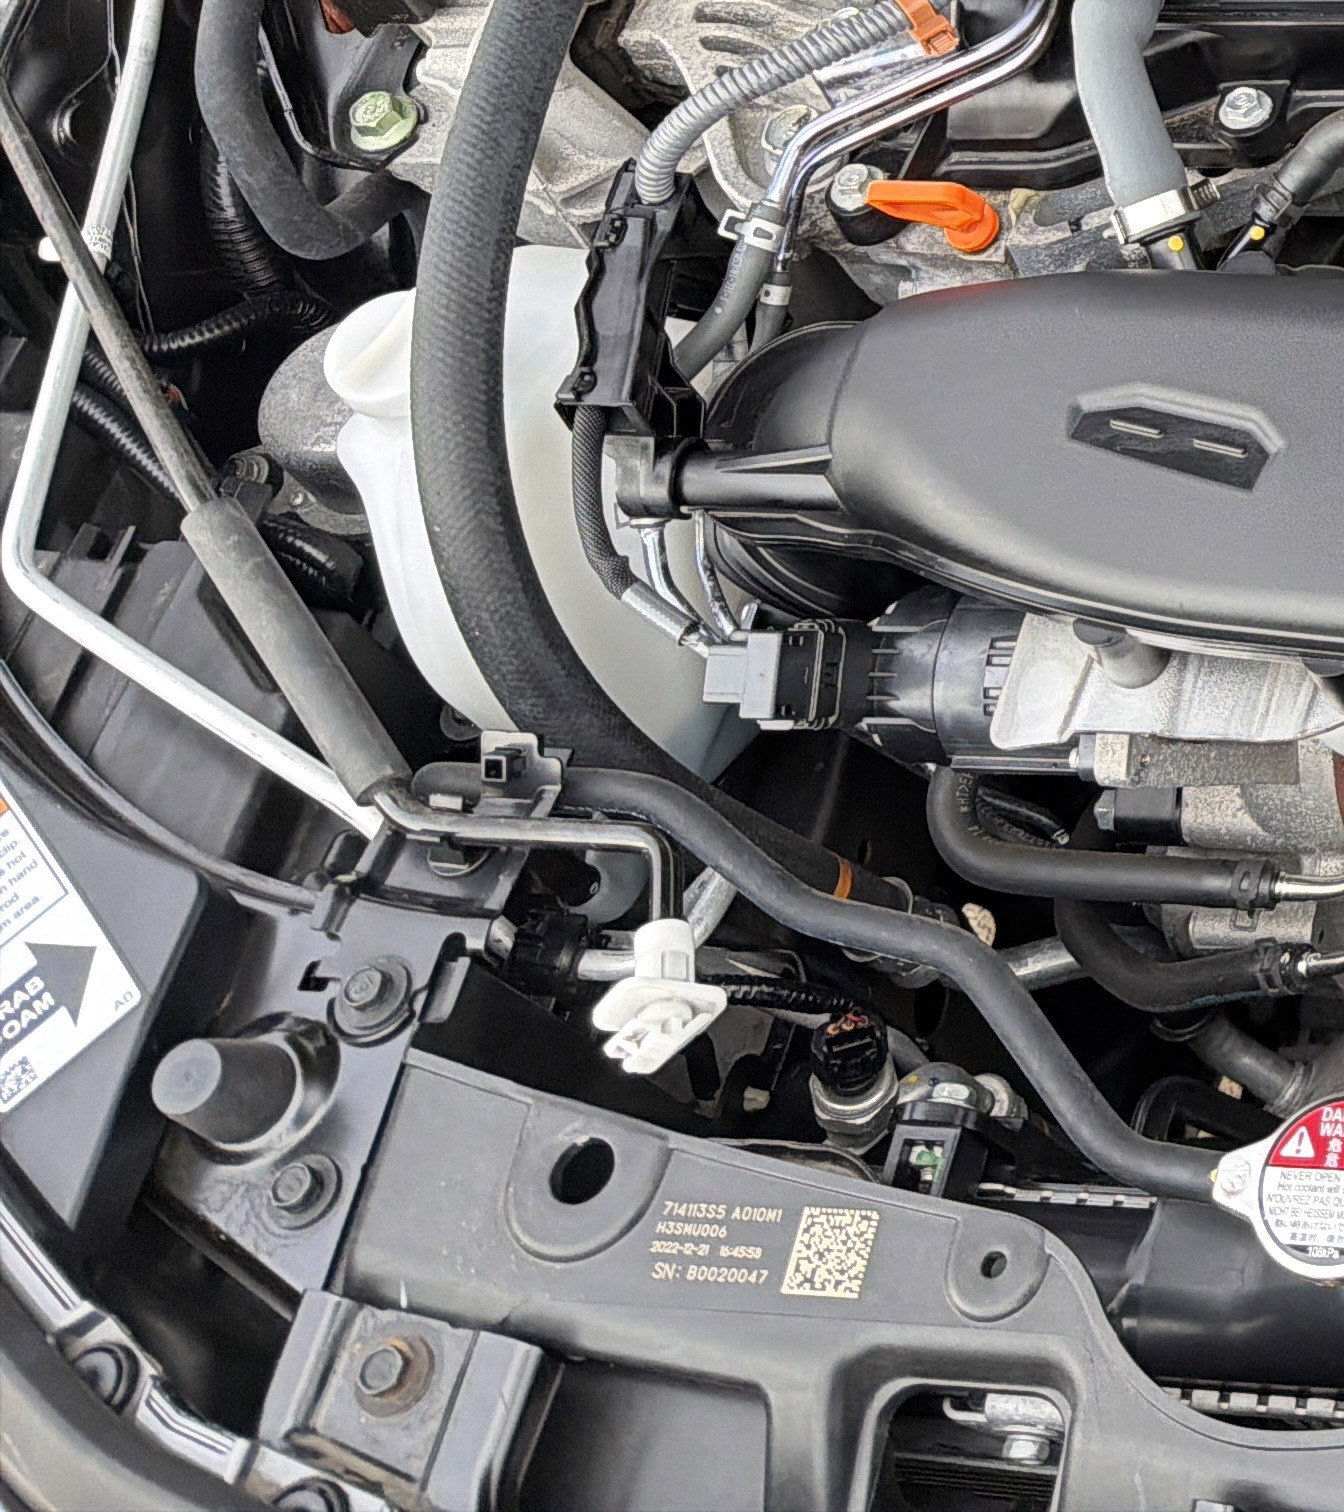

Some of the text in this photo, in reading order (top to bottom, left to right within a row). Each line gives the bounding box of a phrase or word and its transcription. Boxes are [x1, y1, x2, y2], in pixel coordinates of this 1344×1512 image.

[7, 858, 39, 887] hand
[12, 895, 43, 920] area.
[1280, 1170, 1312, 1182] NEVER
[1314, 1172, 1341, 1184] OPEN
[1277, 1182, 1292, 1192] Hot
[1326, 1185, 1341, 1195] will
[1313, 1195, 1332, 1207] PAS
[651, 1261, 769, 1285] SN: B0020047
